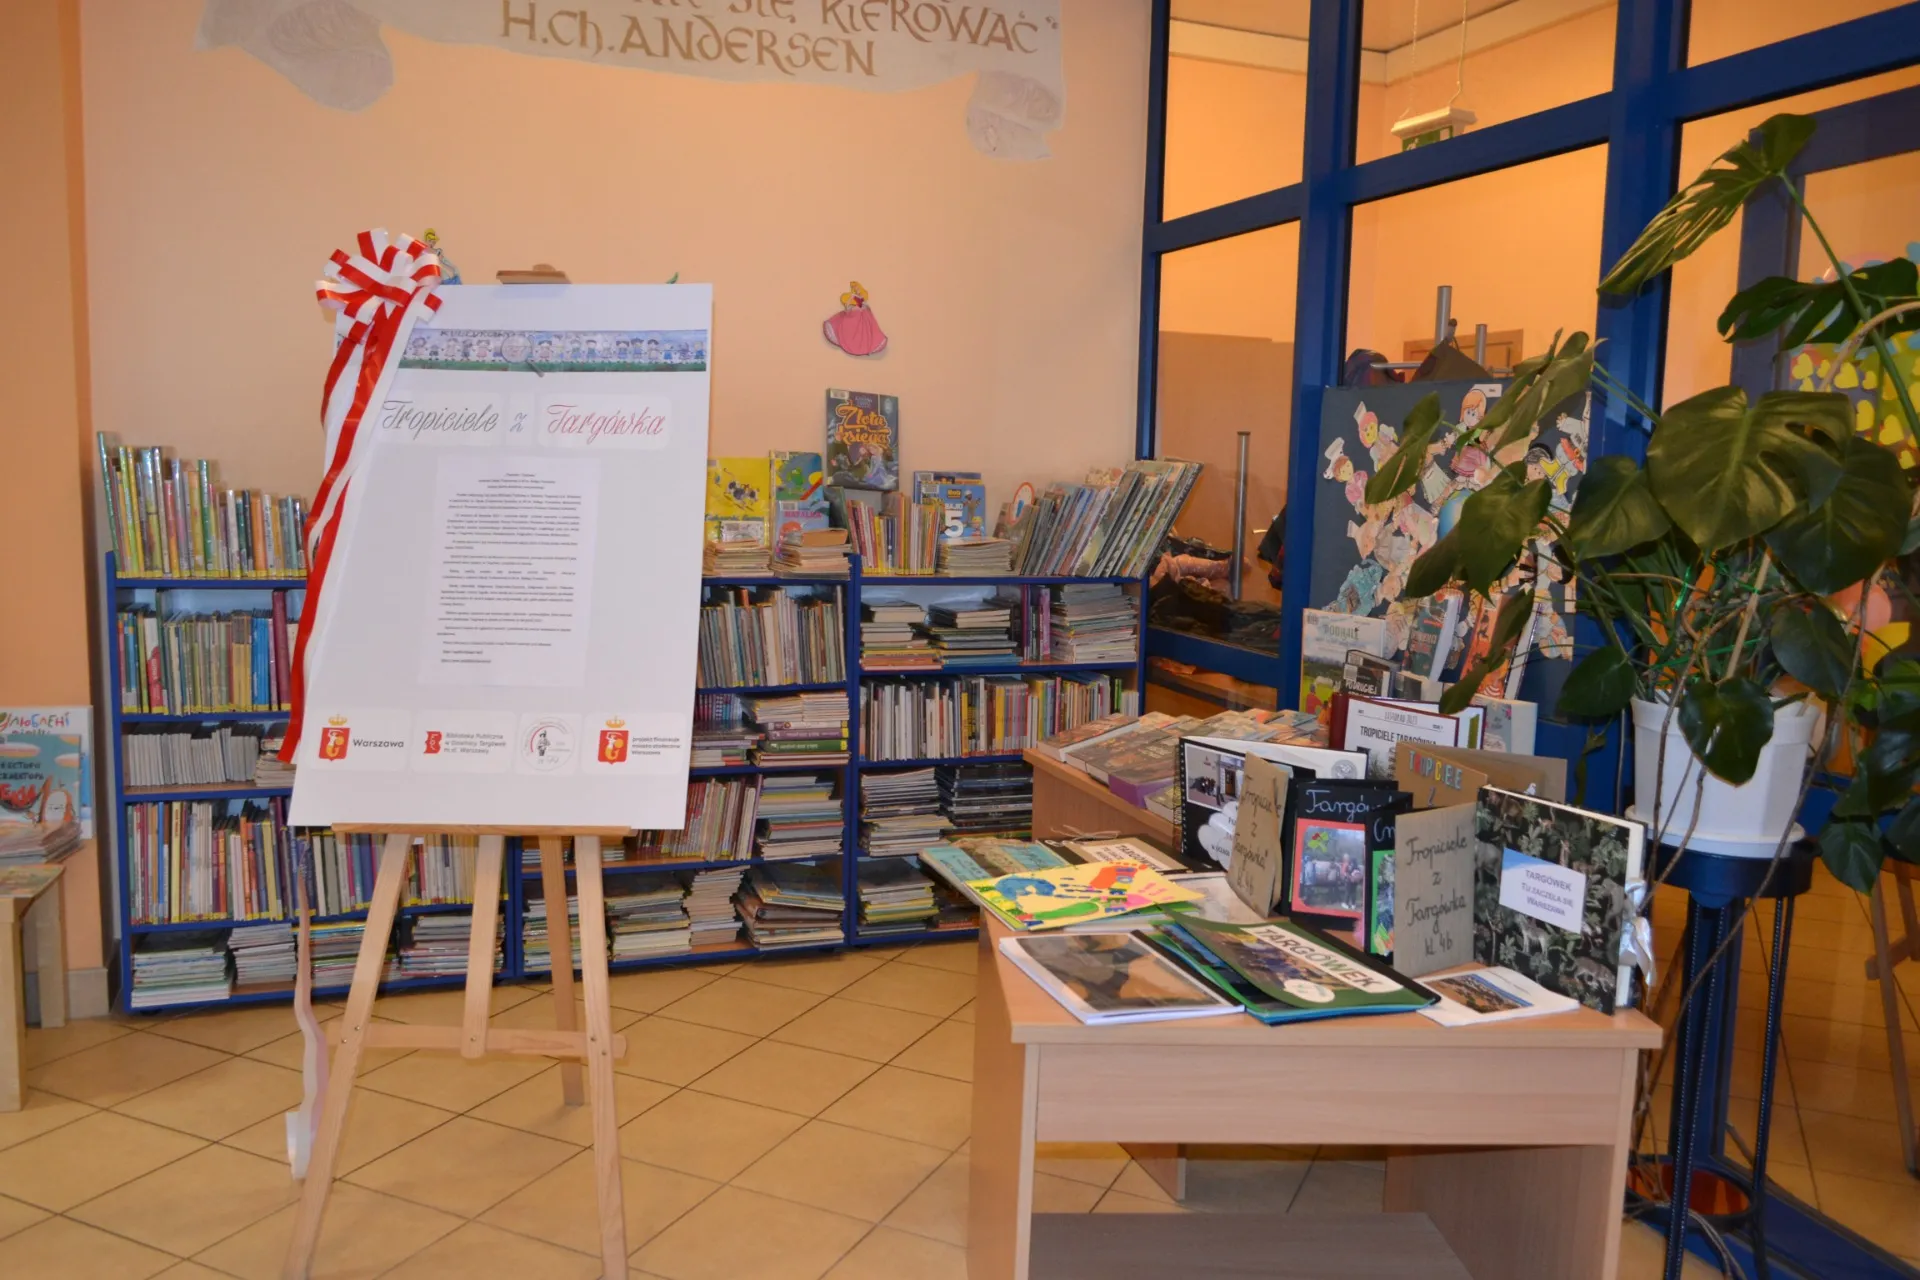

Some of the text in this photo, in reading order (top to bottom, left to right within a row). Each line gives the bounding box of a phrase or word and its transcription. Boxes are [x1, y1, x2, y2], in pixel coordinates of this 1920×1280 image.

[382, 399, 667, 446] Tropiciele z Targówka
[943, 510, 964, 538] 5
[352, 738, 405, 749] Warszawa
[1360, 726, 1395, 743] TROPICIELE
[1405, 826, 1468, 869] Tropiciele
[1405, 889, 1467, 935] Targówka
[1254, 926, 1381, 988] TARGÓWEK
